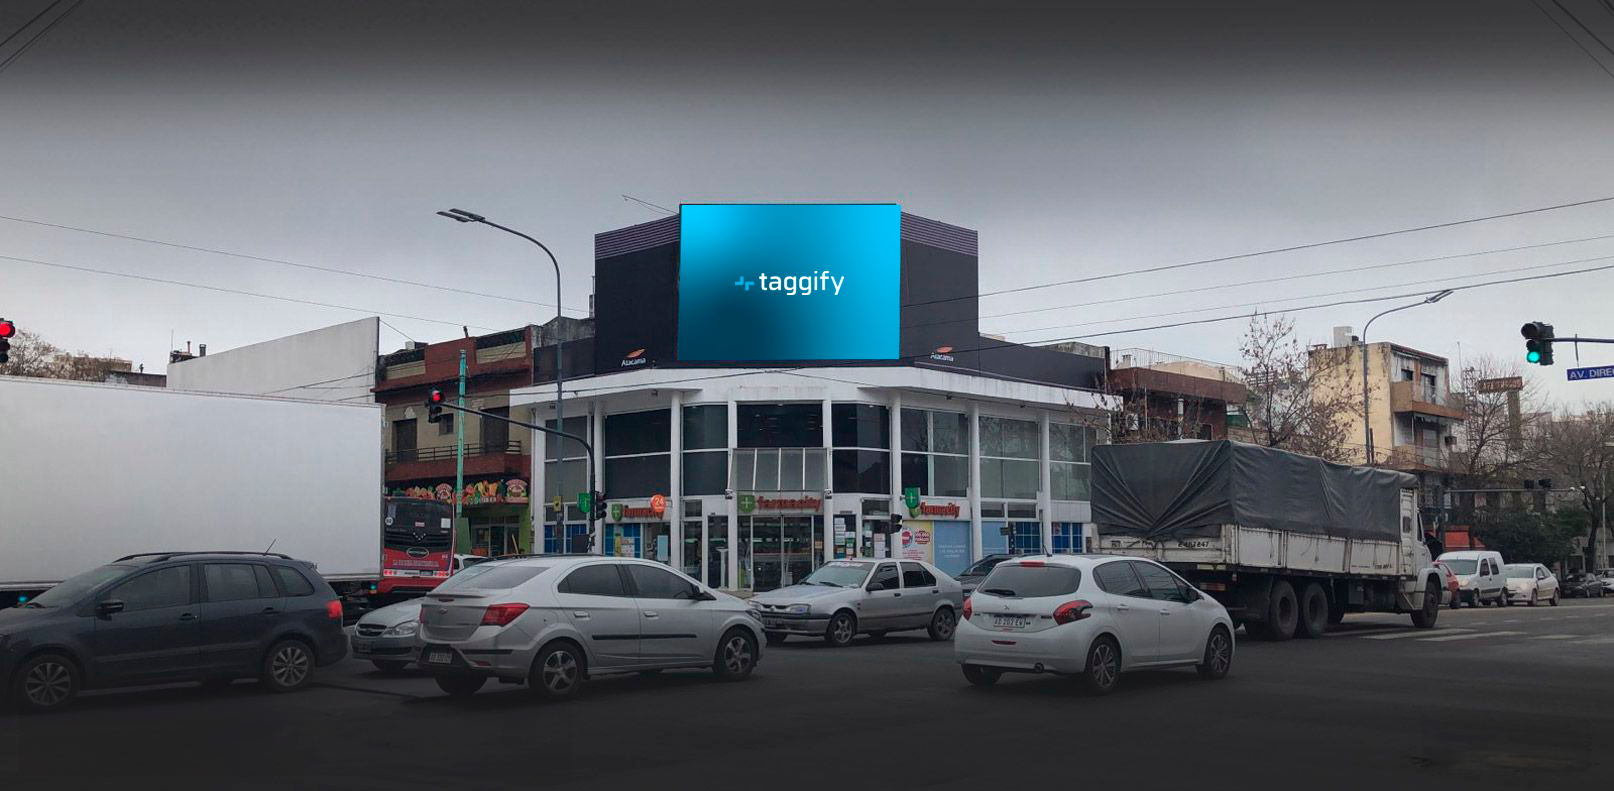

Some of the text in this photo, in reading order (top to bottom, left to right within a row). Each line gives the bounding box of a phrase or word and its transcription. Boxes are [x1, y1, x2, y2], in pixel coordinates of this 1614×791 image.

[758, 270, 845, 296] taggify
[1570, 370, 1588, 379] AV.
[757, 495, 822, 513] farmacity
